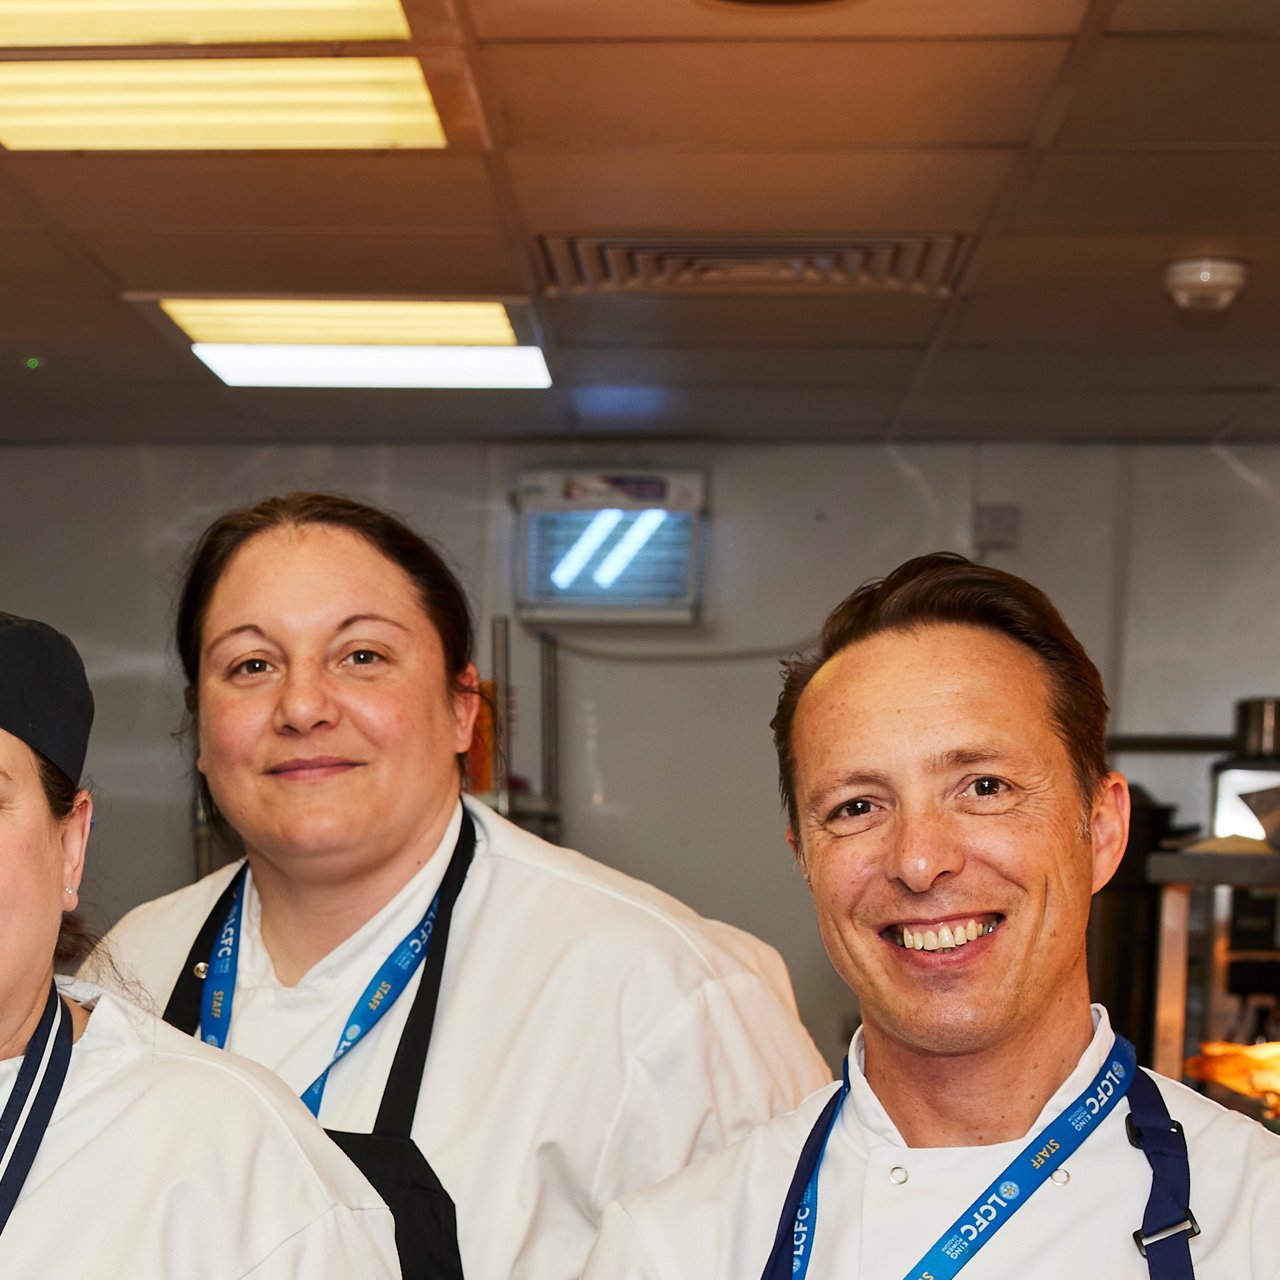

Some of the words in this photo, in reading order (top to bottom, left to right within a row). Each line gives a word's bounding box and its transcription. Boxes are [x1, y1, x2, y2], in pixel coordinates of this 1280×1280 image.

[217, 918, 236, 958] LCFC
[409, 911, 436, 954] LCFC
[211, 990, 224, 1019] STAFF
[368, 981, 392, 1011] STAFF
[1085, 1070, 1120, 1115] LCFC
[1074, 1113, 1092, 1132] KING
[1031, 1139, 1060, 1169] STAFF
[793, 1207, 810, 1256] LCFC
[960, 1193, 1008, 1241] LCFC
[945, 1237, 964, 1256] POWER
[950, 1240, 969, 1260] KING
